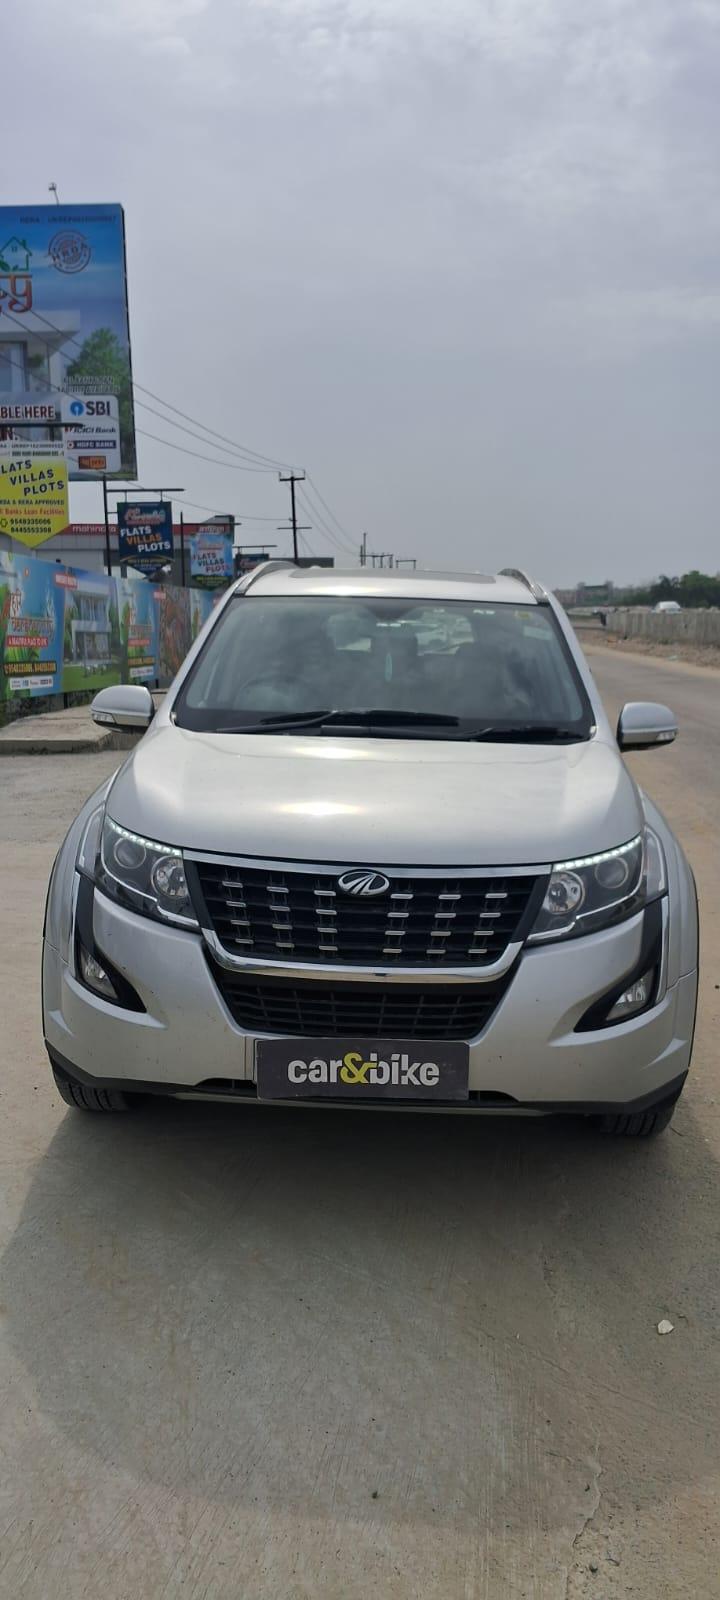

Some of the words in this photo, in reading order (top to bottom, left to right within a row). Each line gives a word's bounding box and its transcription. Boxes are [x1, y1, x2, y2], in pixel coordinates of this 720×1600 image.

[24, 406, 54, 418] HERE
[86, 401, 110, 416] SBI
[10, 469, 54, 486] VILLAS
[24, 480, 64, 496] PLOTS
[120, 526, 151, 537] FLATS
[126, 533, 162, 545] VILLAS
[138, 541, 171, 552] PLOTS
[197, 558, 224, 566] VILLAS
[287, 1052, 439, 1086] car&bike
